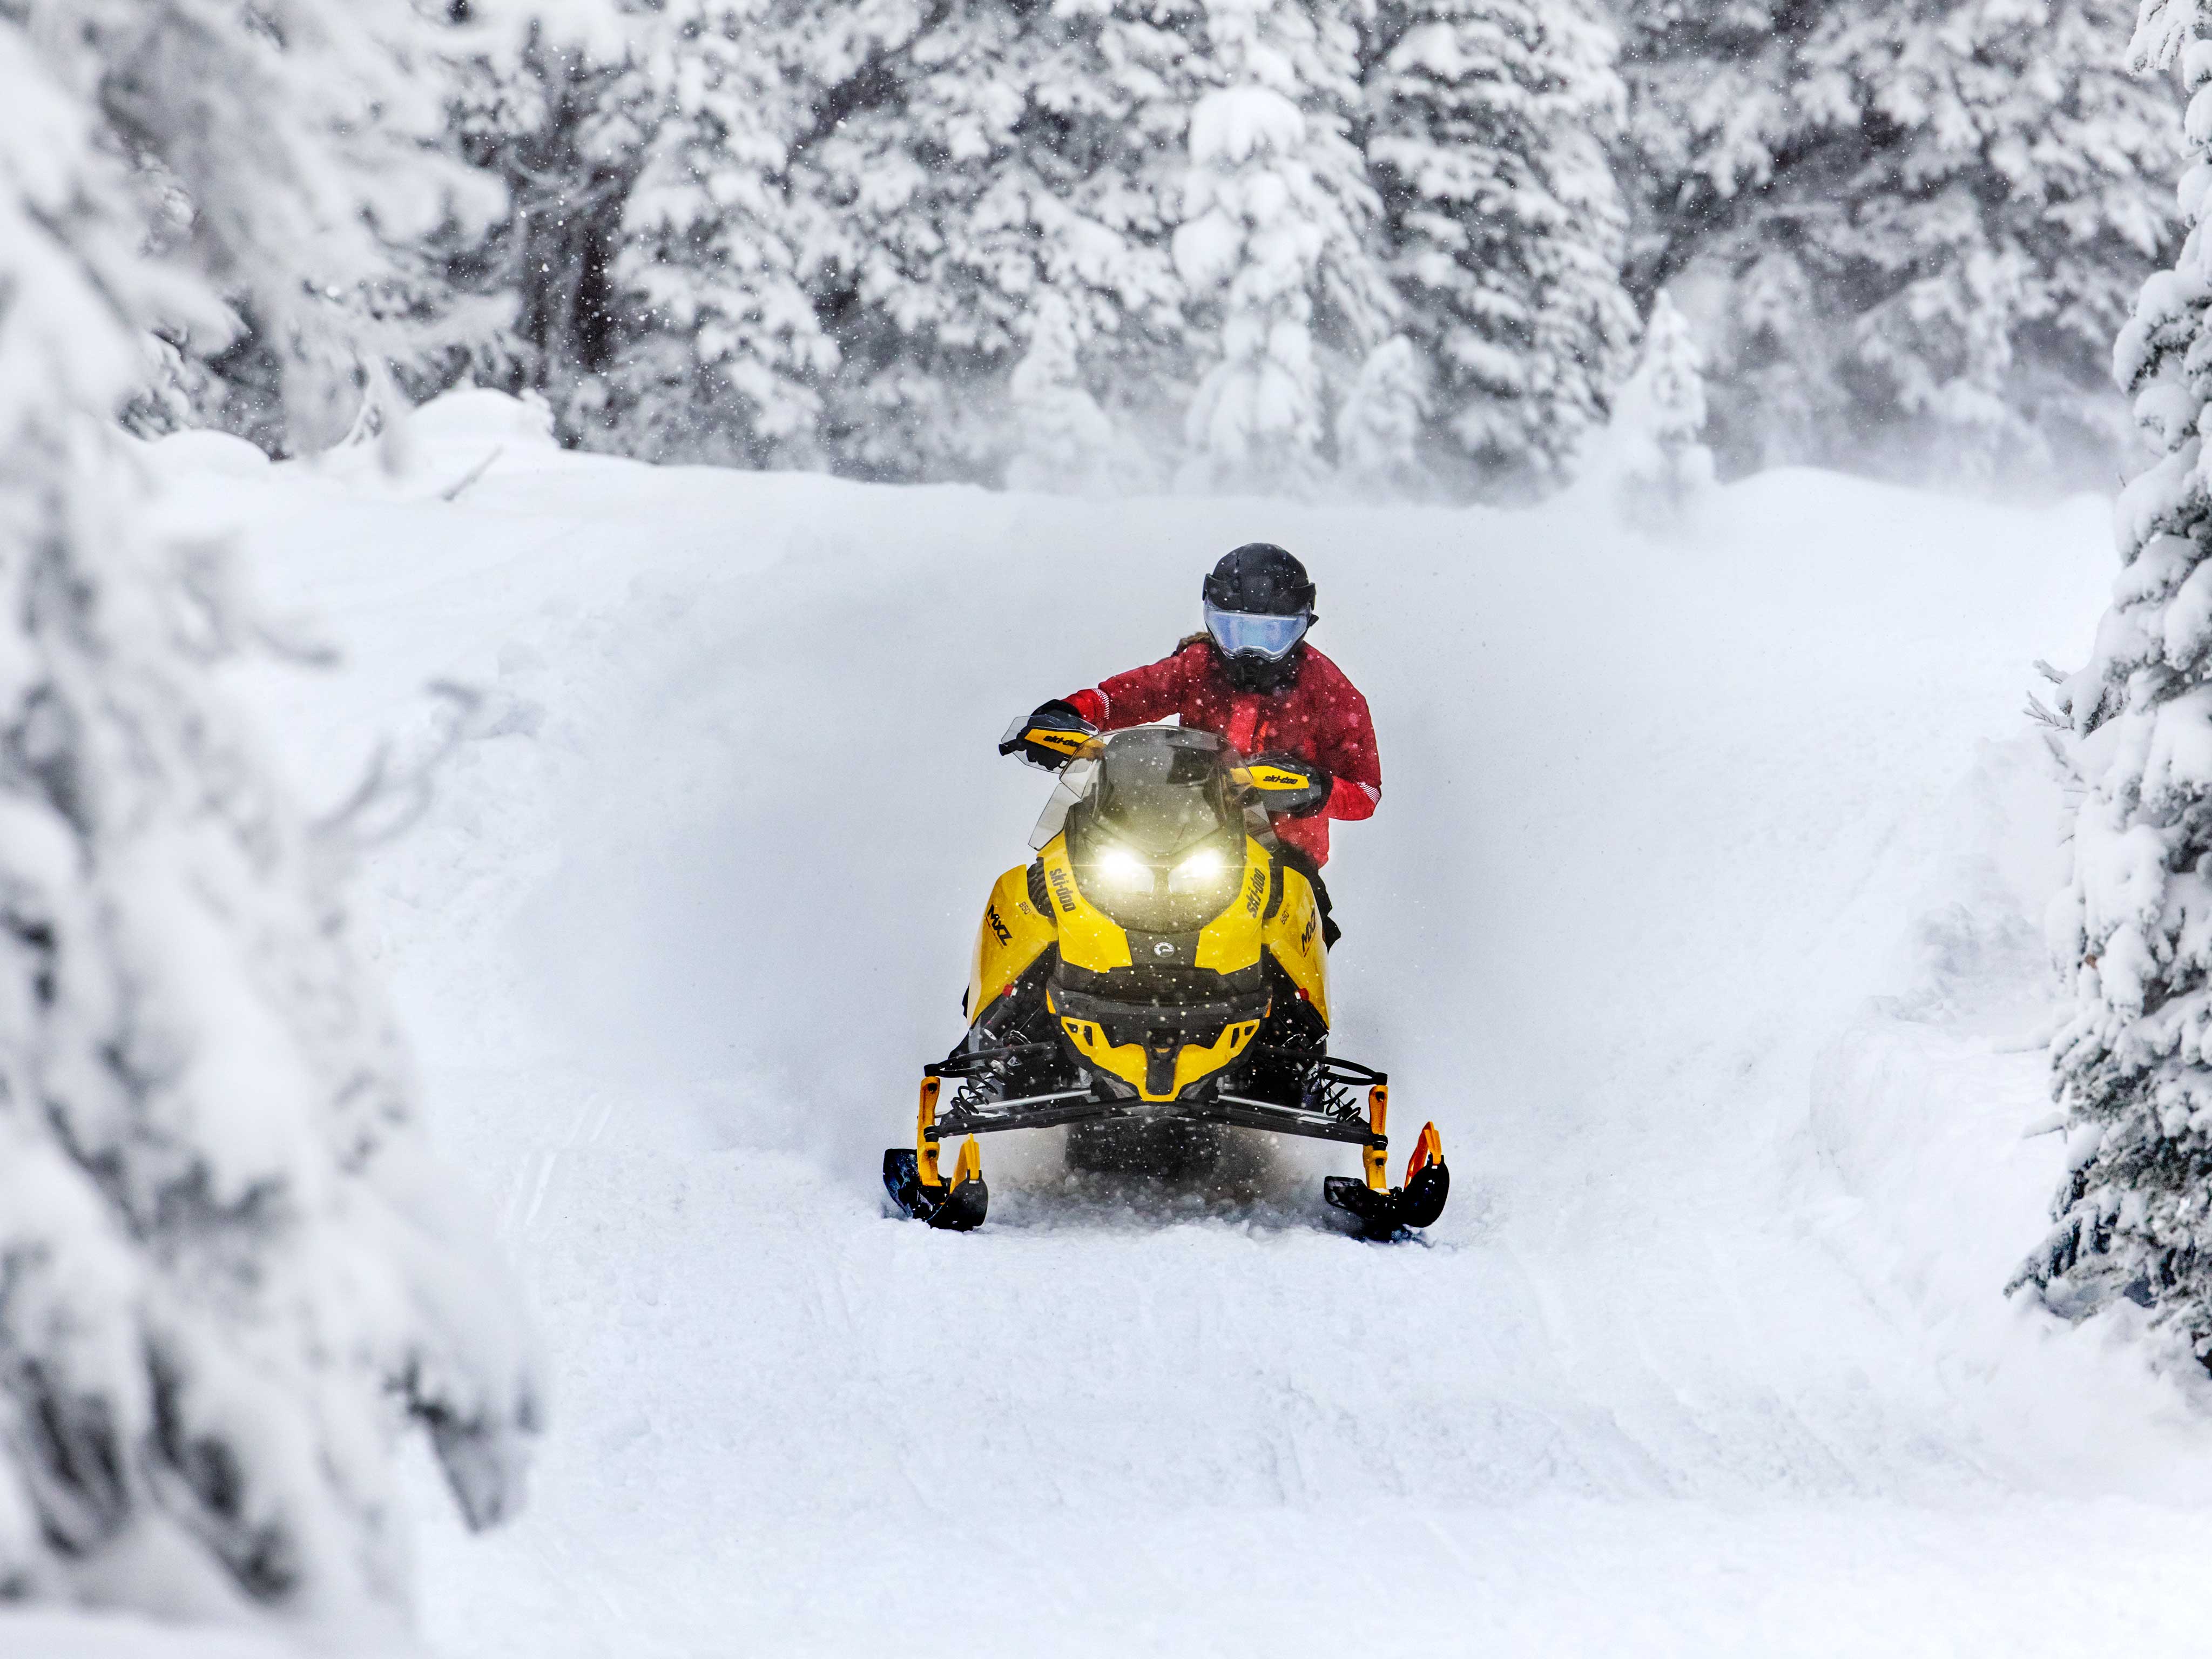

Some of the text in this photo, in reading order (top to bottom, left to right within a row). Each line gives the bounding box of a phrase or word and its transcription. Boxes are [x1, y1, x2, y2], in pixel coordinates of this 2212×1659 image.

[1263, 775, 1298, 785] ski-doo
[1019, 901, 1031, 914] 850
[1049, 868, 1076, 912] ski-doo
[1246, 867, 1266, 919] ski-doo
[987, 904, 1013, 946] MXZ
